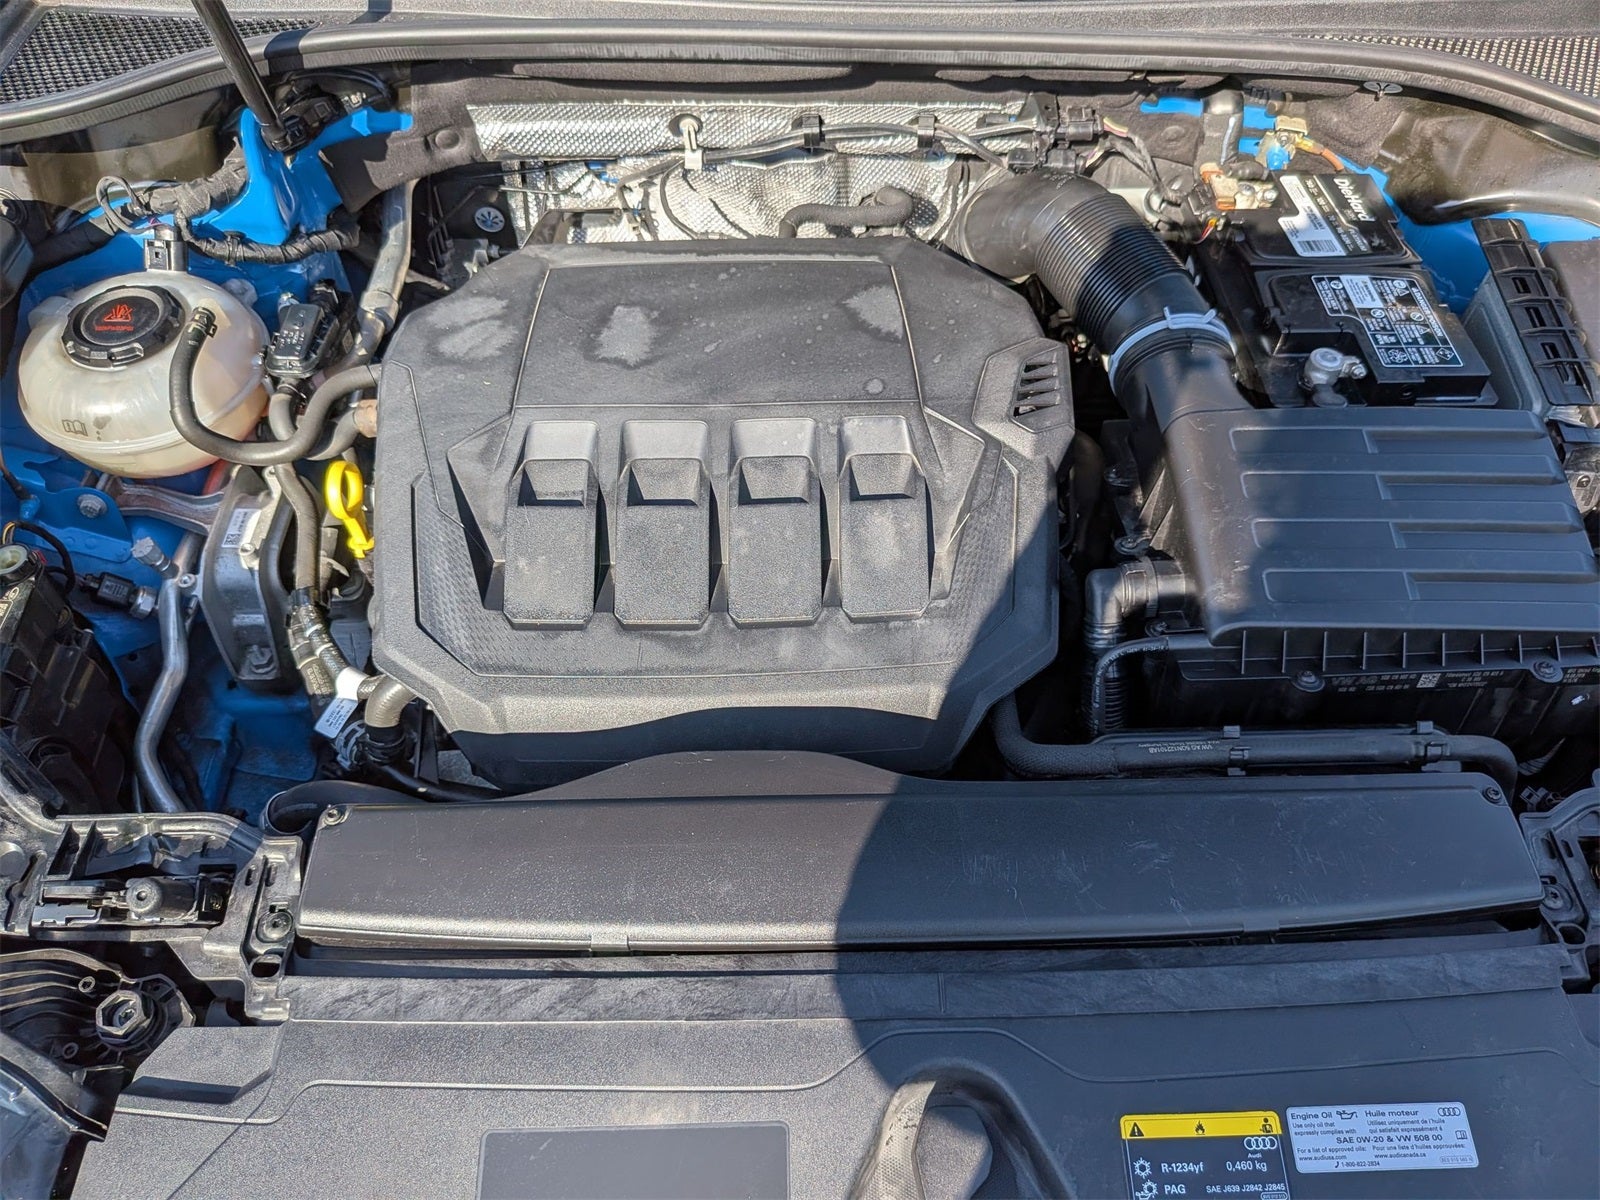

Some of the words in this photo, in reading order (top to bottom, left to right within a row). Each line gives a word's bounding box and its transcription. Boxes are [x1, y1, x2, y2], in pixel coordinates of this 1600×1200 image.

[1333, 178, 1376, 222] DieHard
[1414, 292, 1431, 315] DANGER
[1427, 315, 1443, 336] POISON
[1161, 1162, 1204, 1174] R-1234yf
[1226, 1161, 1252, 1172] 0,460
[1255, 1161, 1267, 1172] kg
[1164, 1184, 1186, 1194] PAG
